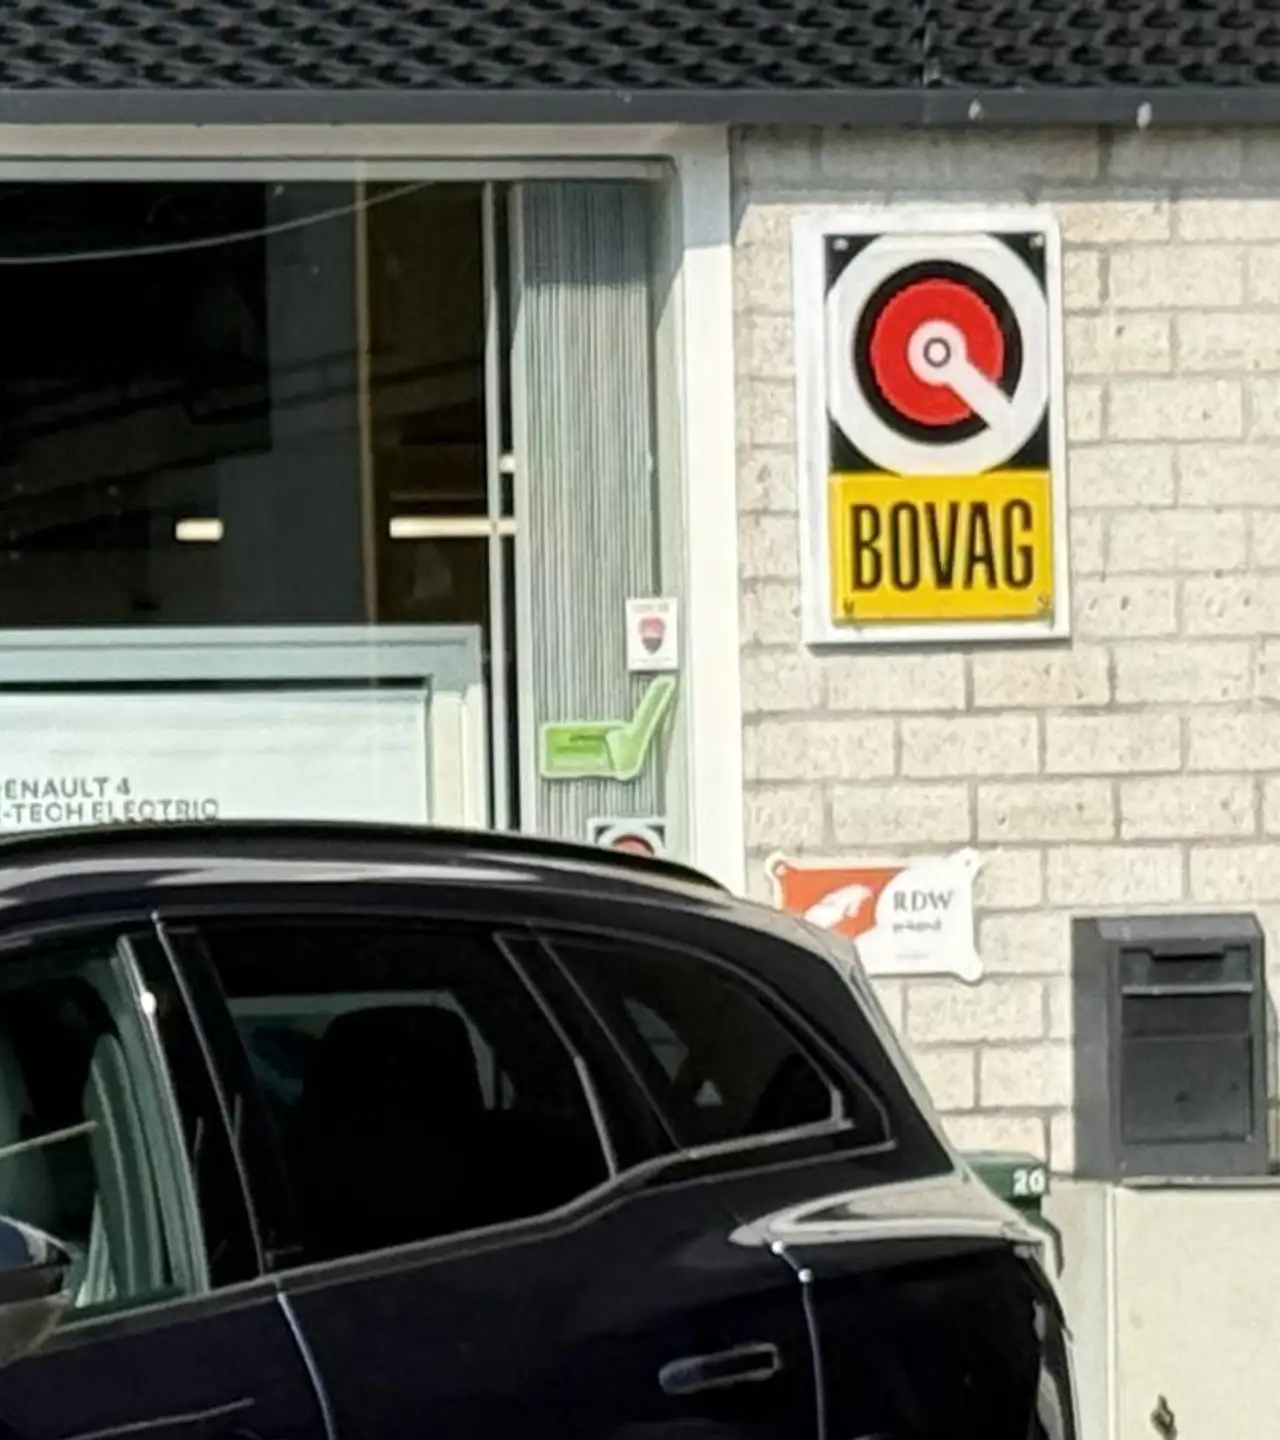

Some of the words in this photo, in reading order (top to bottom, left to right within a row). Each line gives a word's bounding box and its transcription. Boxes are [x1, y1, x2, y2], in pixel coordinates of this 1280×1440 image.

[849, 498, 1034, 592] BOVAG
[116, 777, 131, 797] 4
[893, 888, 955, 913] RDW
